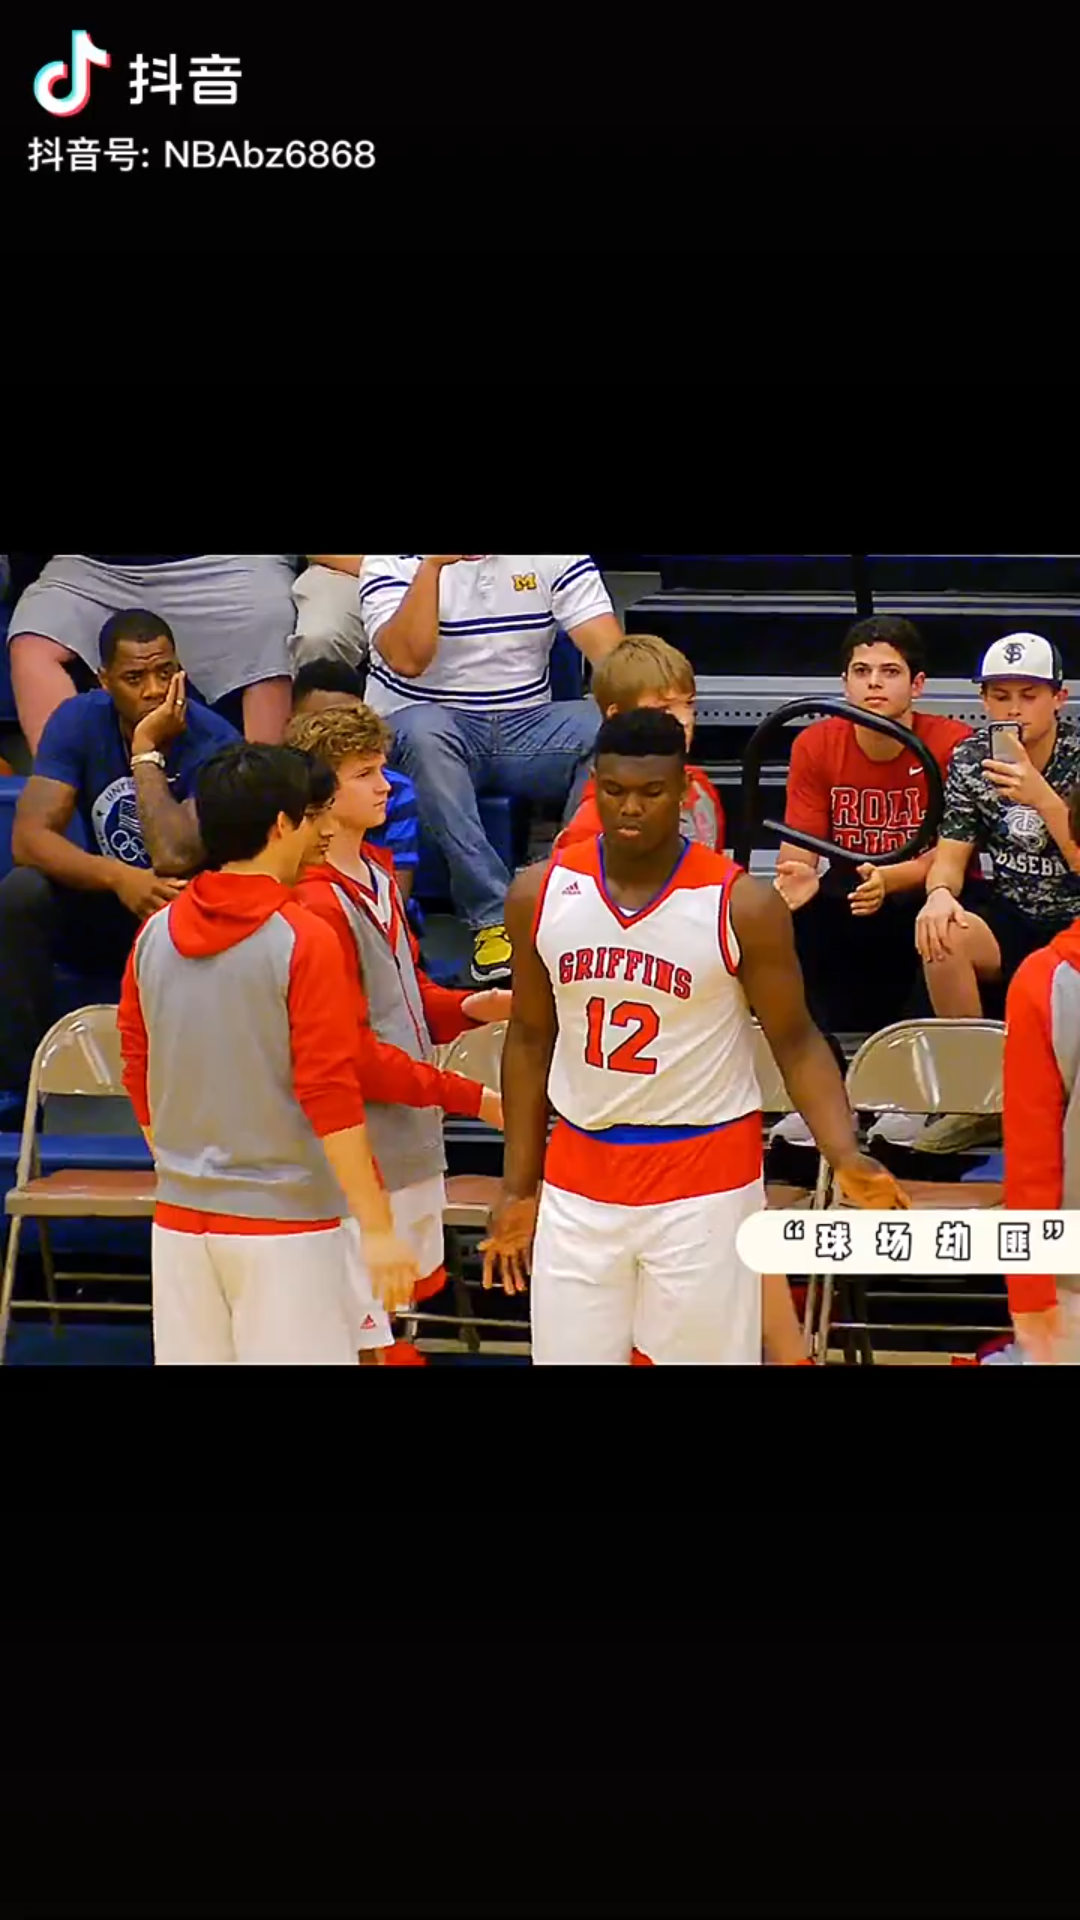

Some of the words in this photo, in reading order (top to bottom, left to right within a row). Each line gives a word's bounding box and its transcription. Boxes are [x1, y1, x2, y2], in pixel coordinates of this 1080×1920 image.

[512, 572, 537, 591] M
[831, 787, 927, 829] ROLL
[833, 826, 918, 854] TID
[559, 947, 692, 1000] GRIFFINS
[585, 996, 660, 1075] 12
